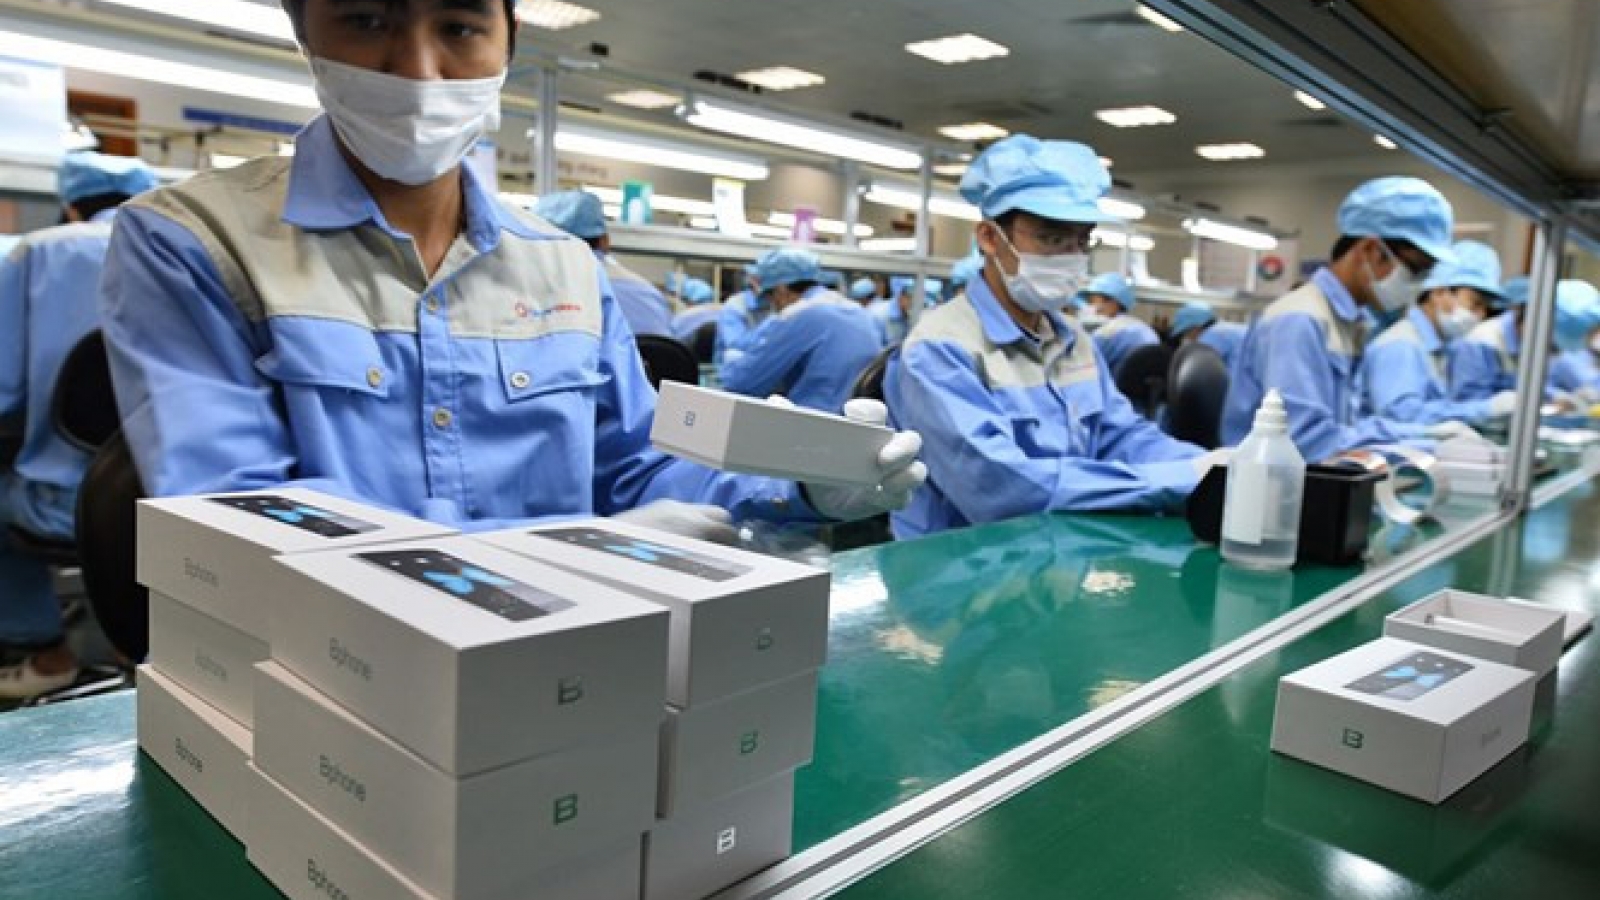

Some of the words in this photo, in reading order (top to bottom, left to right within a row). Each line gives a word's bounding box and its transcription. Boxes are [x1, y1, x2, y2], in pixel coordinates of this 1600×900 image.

[329, 637, 372, 682] Bphone
[557, 676, 583, 705] B
[741, 730, 759, 754] B
[1343, 728, 1364, 749] B
[319, 754, 367, 802] Bphone
[554, 793, 579, 825] B
[716, 825, 737, 854] B
